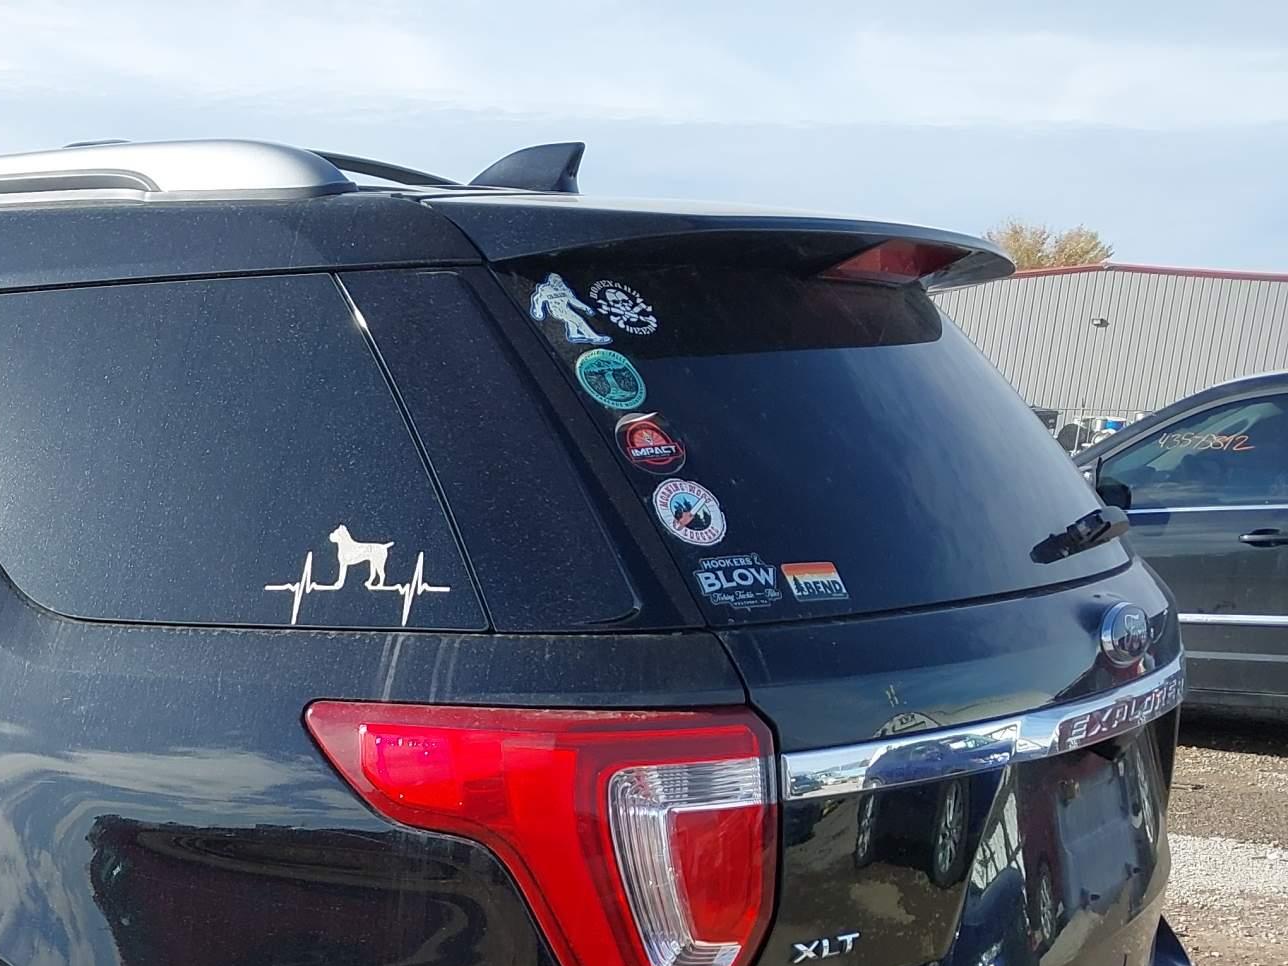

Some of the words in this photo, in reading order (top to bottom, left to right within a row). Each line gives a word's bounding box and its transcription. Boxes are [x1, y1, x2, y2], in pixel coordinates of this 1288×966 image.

[631, 445, 676, 457] IMPACT
[703, 557, 752, 570] HOOKERS
[696, 567, 774, 594] BLOW
[803, 579, 843, 595] BEND
[793, 932, 860, 964] XLT
